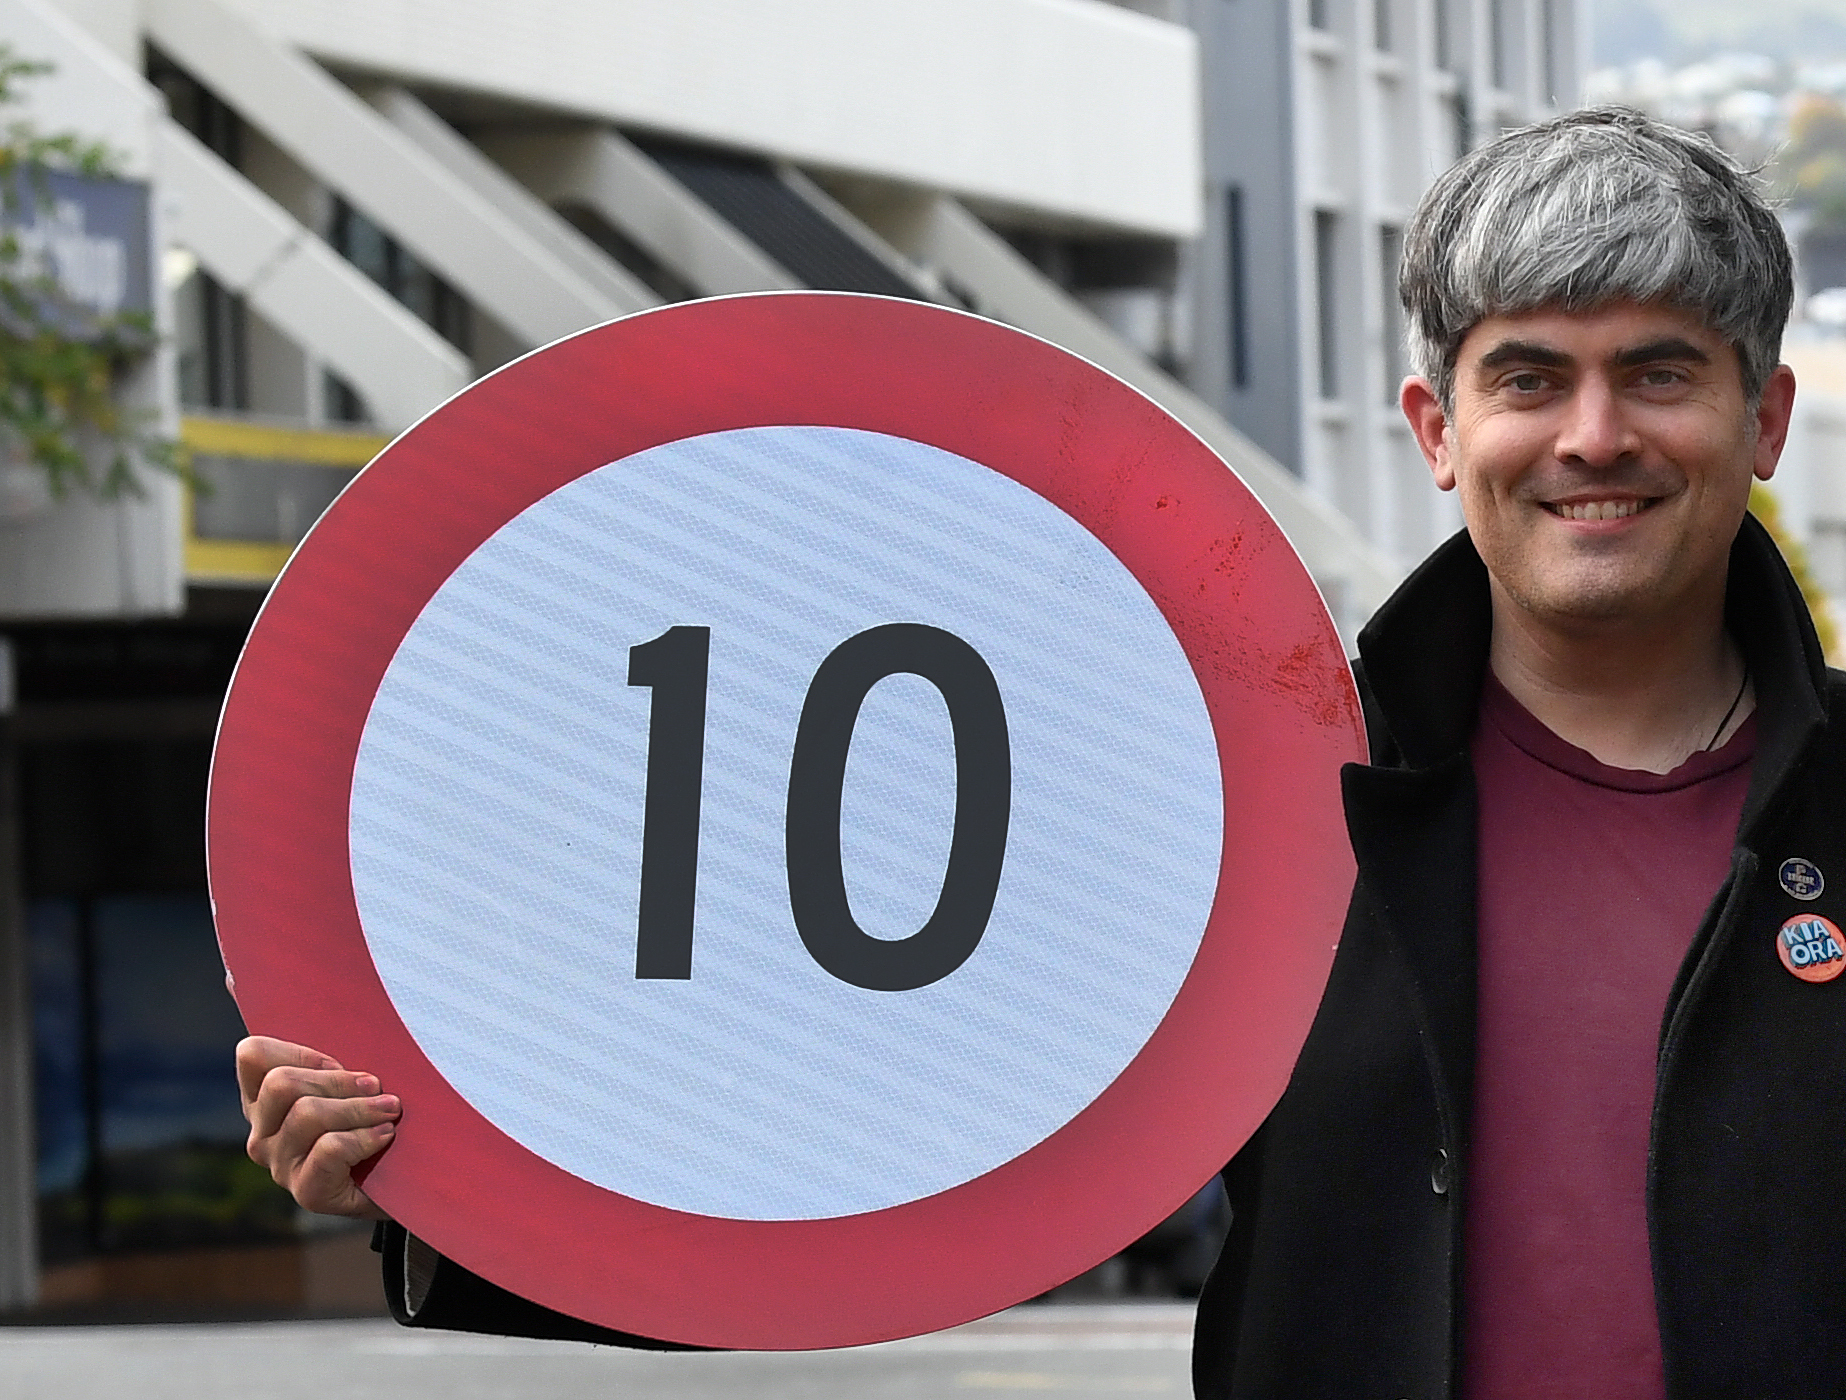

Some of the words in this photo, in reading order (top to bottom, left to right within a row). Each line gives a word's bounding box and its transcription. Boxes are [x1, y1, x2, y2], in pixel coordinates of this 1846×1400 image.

[626, 622, 1012, 992] 10
[1782, 920, 1830, 945] KIA
[1790, 938, 1843, 964] ORA
